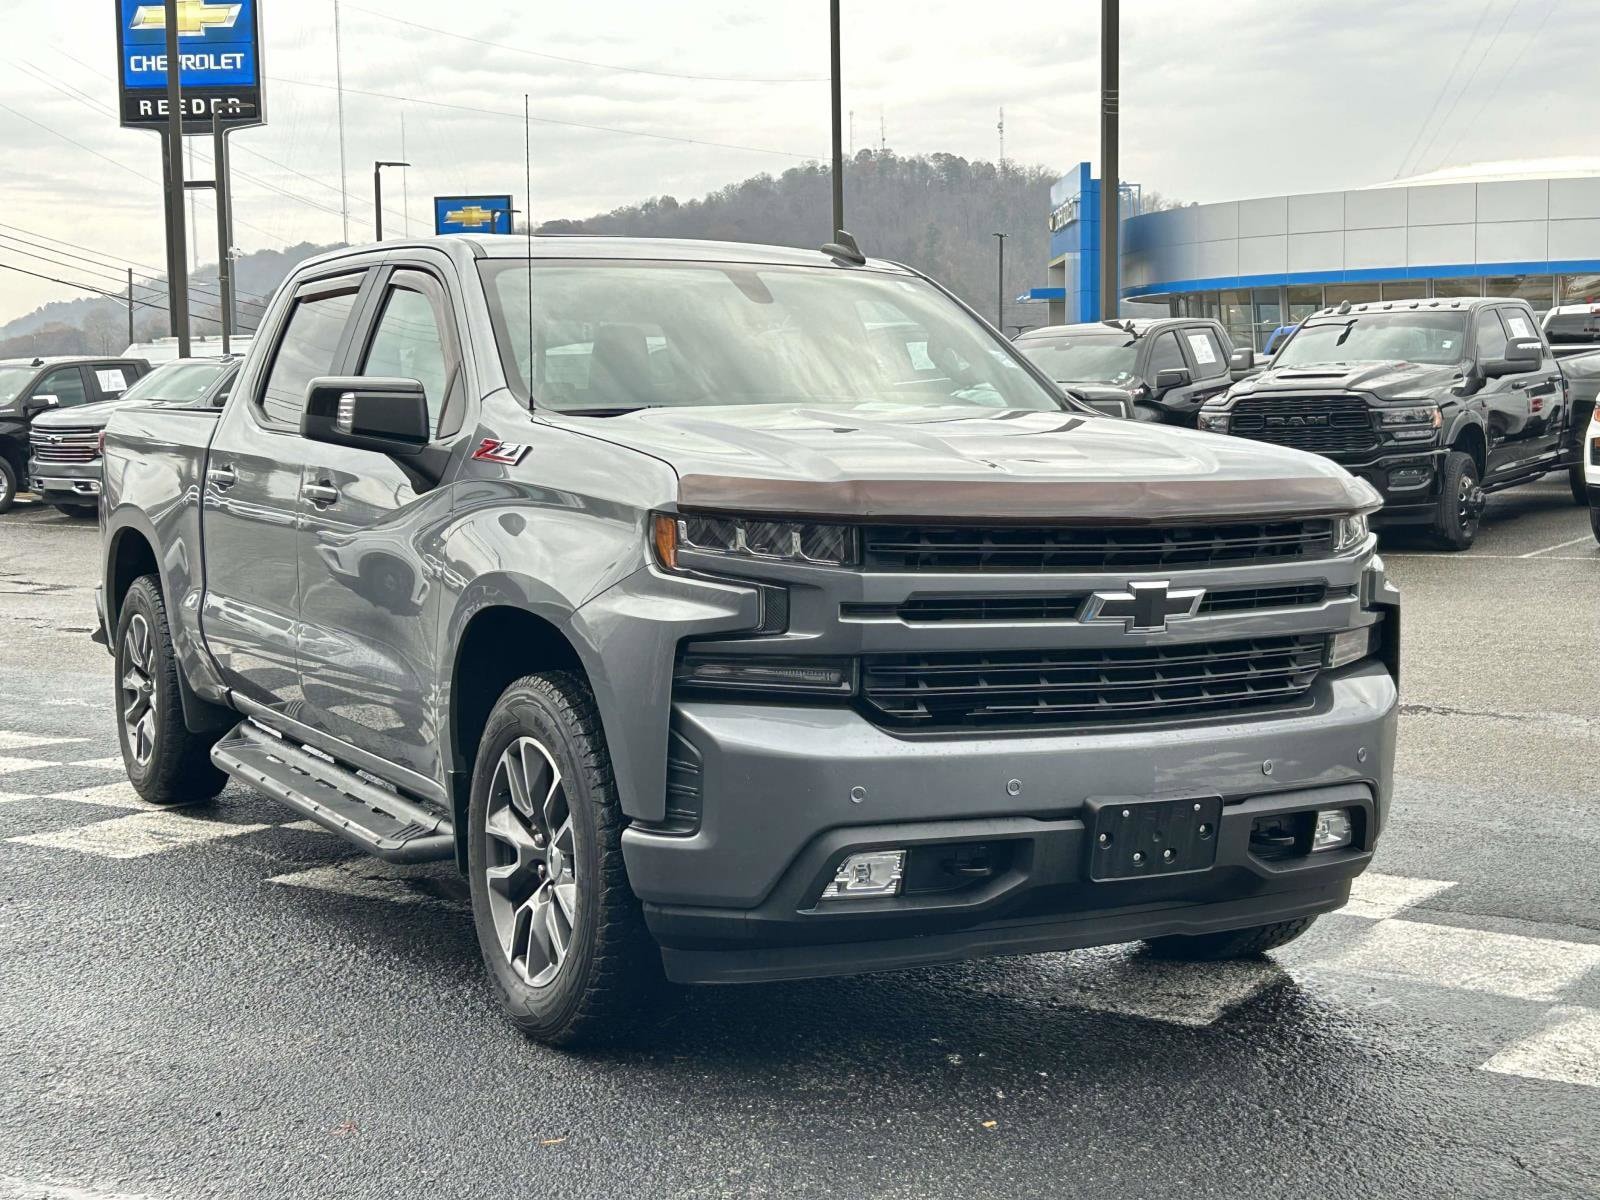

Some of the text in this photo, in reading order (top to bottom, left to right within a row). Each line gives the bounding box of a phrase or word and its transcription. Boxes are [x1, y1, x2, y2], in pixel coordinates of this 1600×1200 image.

[130, 53, 244, 72] CHEROLET
[1265, 415, 1327, 426] RAM
[471, 437, 533, 466] Z71
